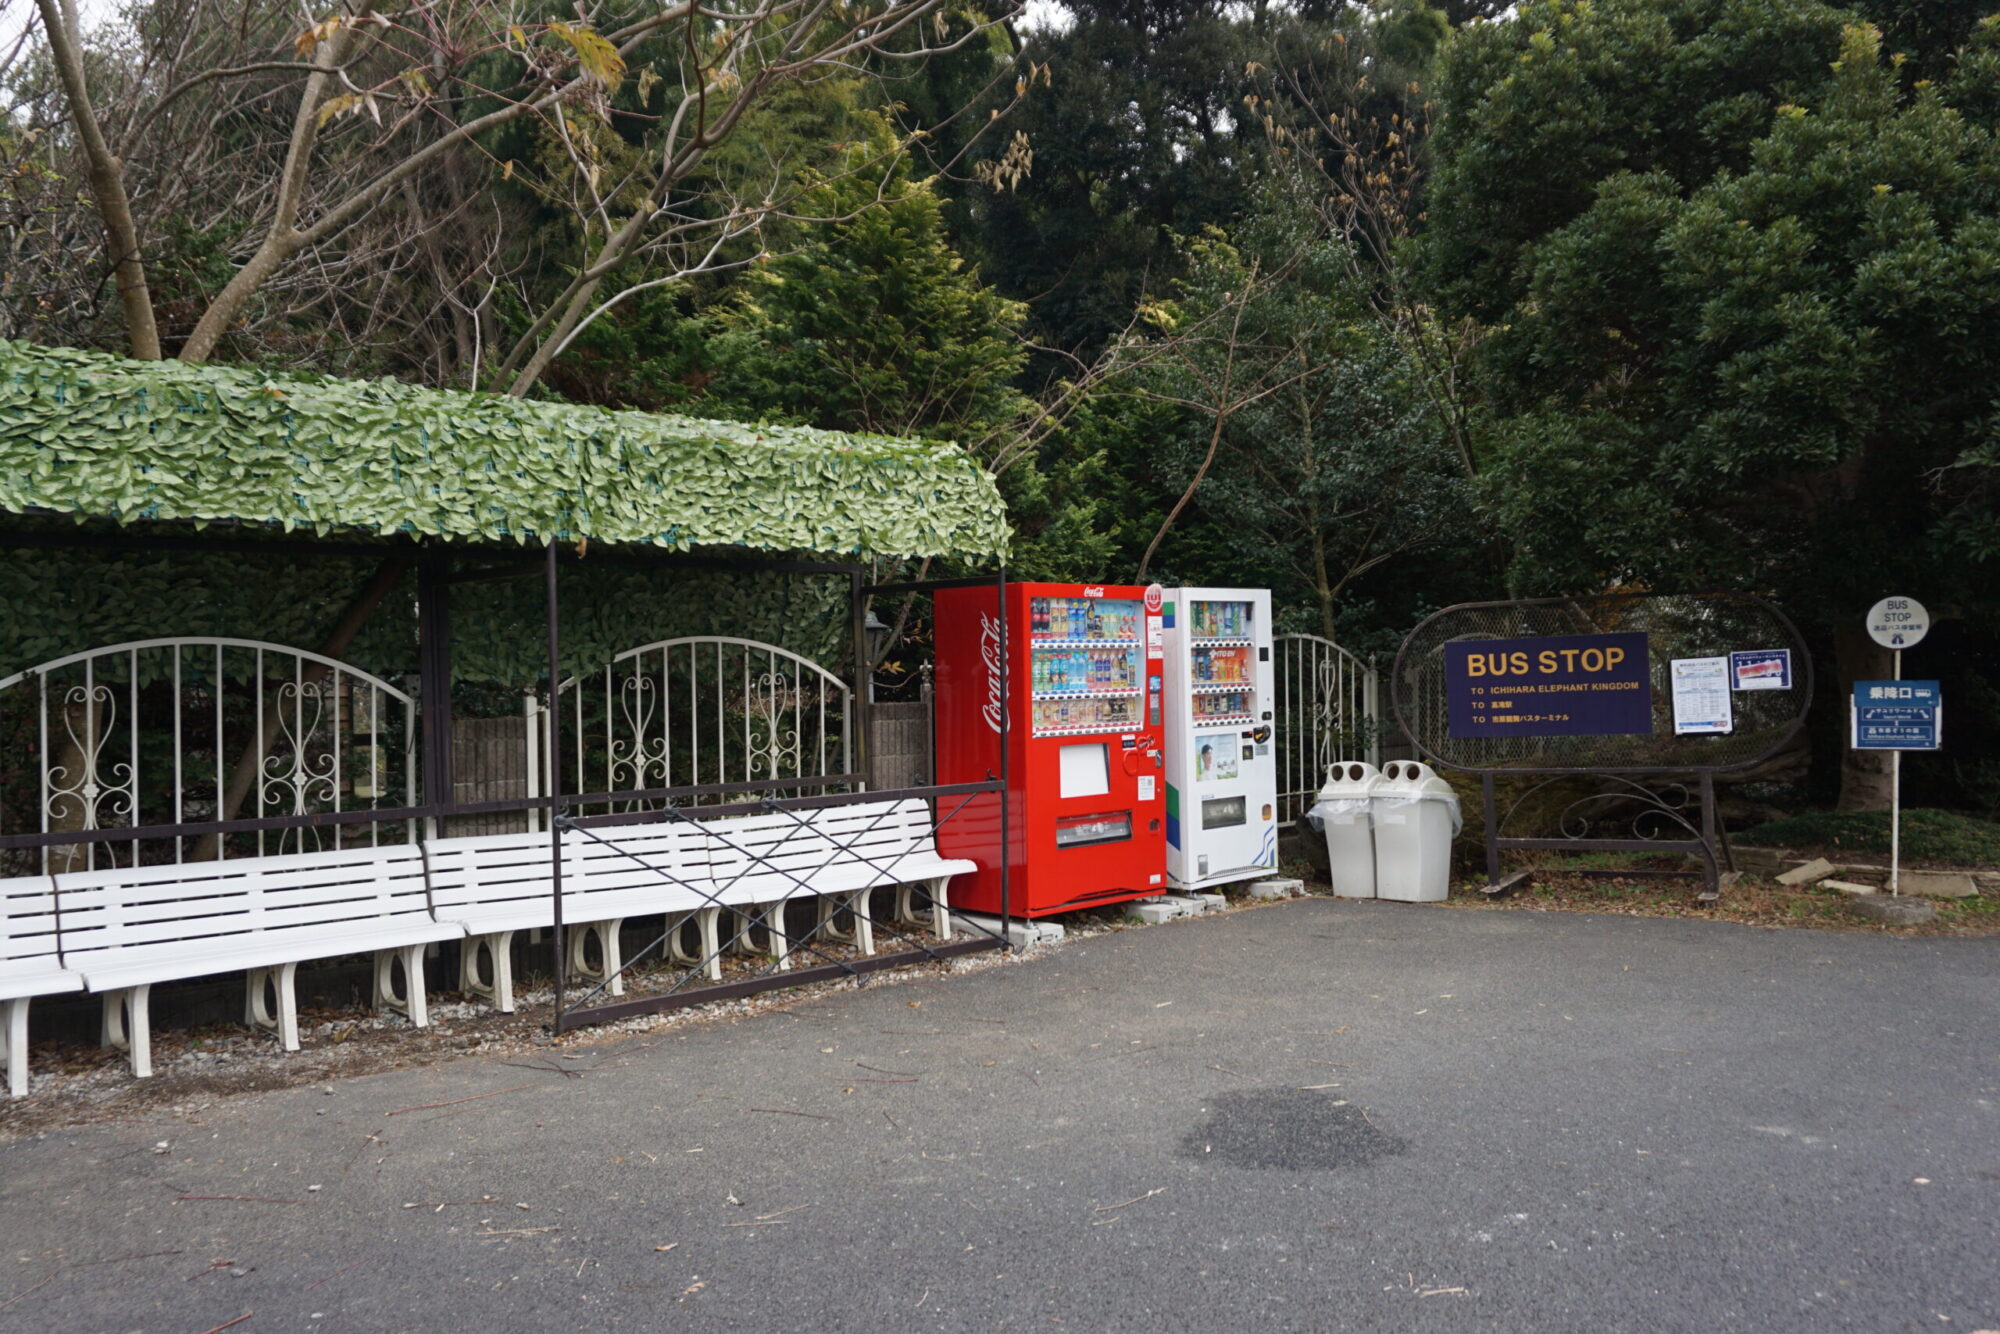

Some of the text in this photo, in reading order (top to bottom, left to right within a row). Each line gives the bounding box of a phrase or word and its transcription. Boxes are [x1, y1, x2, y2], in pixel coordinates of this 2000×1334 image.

[1887, 600, 1908, 610] BUS
[1884, 613, 1912, 623] STOP
[1468, 648, 1624, 676] BUS STOP
[1471, 681, 1639, 695] TO ICHIHARA ELEPHANT KINGDOM
[1870, 687, 1912, 699] 乗降口
